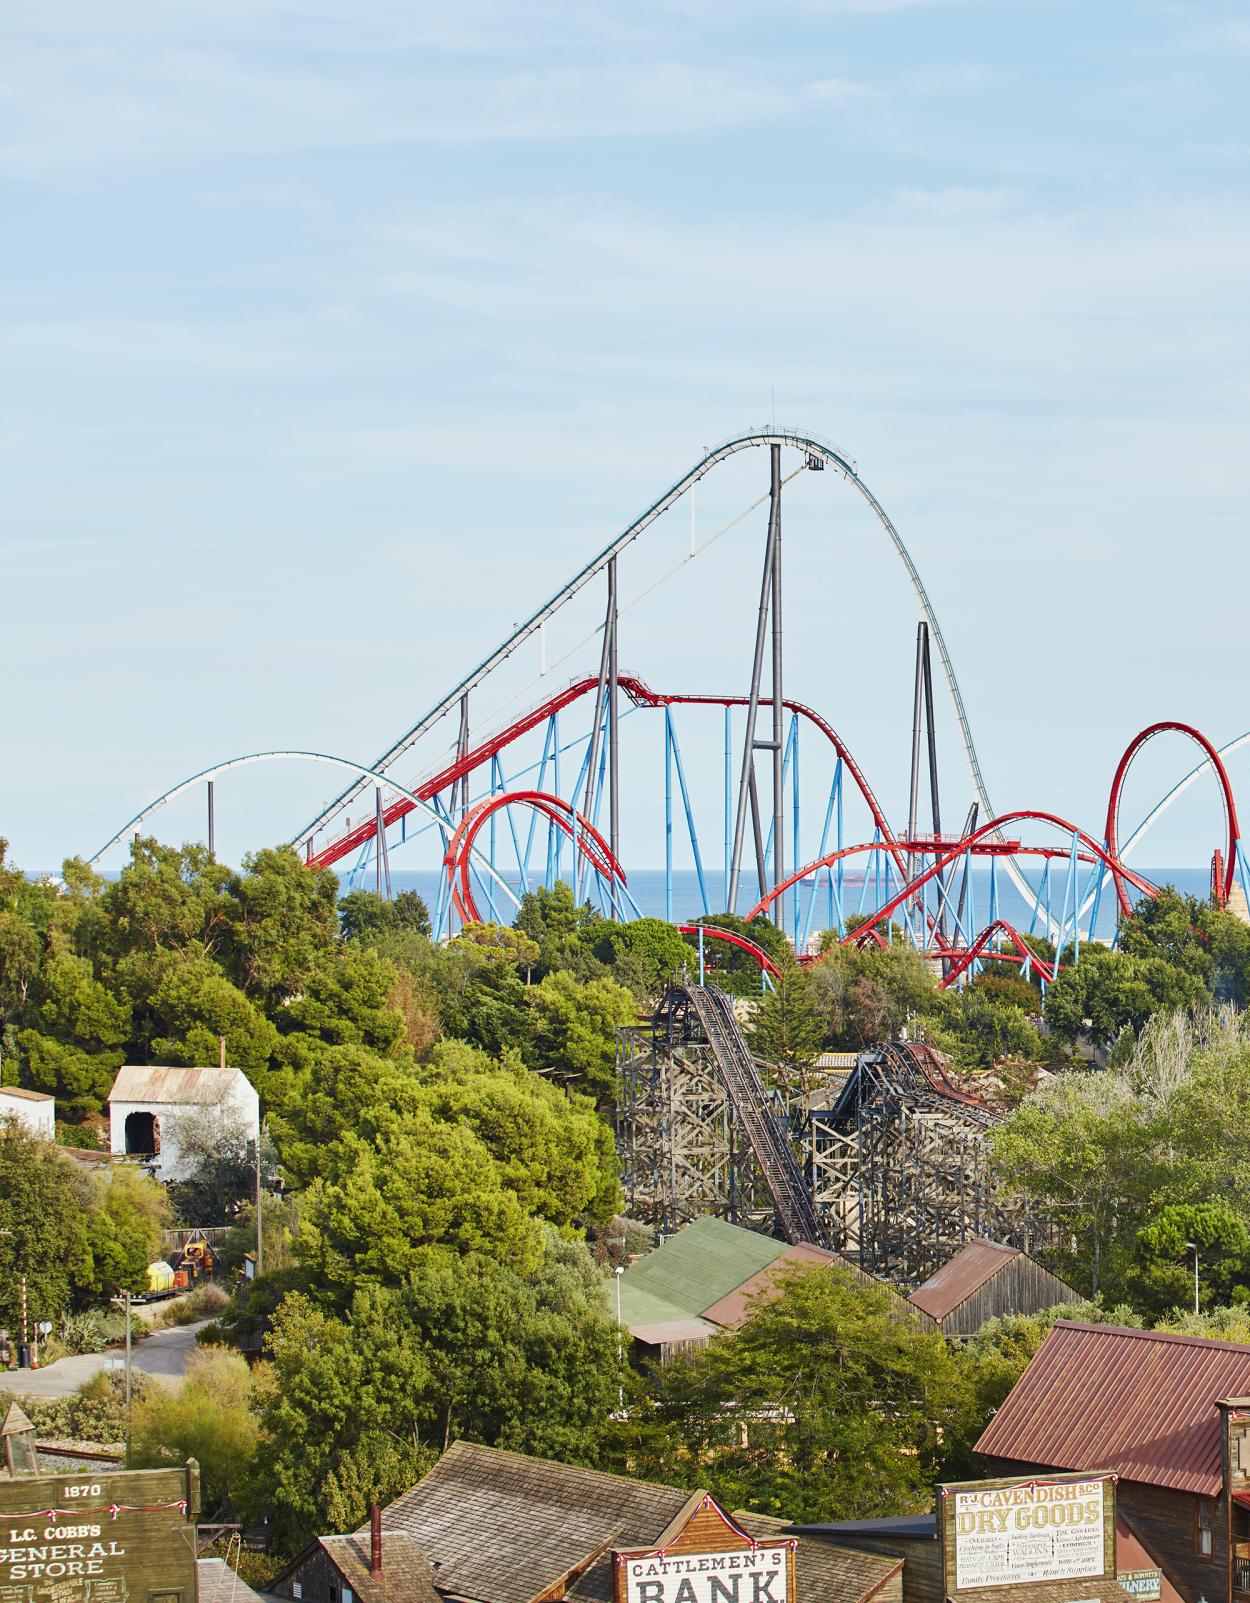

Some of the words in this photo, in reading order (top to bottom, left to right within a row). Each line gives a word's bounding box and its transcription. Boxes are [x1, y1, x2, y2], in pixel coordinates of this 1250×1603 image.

[64, 1485, 101, 1498] 1870
[980, 1485, 1078, 1508] CAVENDISH
[957, 1507, 1013, 1536] DRY
[1014, 1500, 1101, 1531] GOODS
[10, 1528, 38, 1542] L.C.
[44, 1524, 101, 1540] COBB'S
[10, 1560, 104, 1580] STORE
[632, 1552, 782, 1578] CATTLEMEN'S
